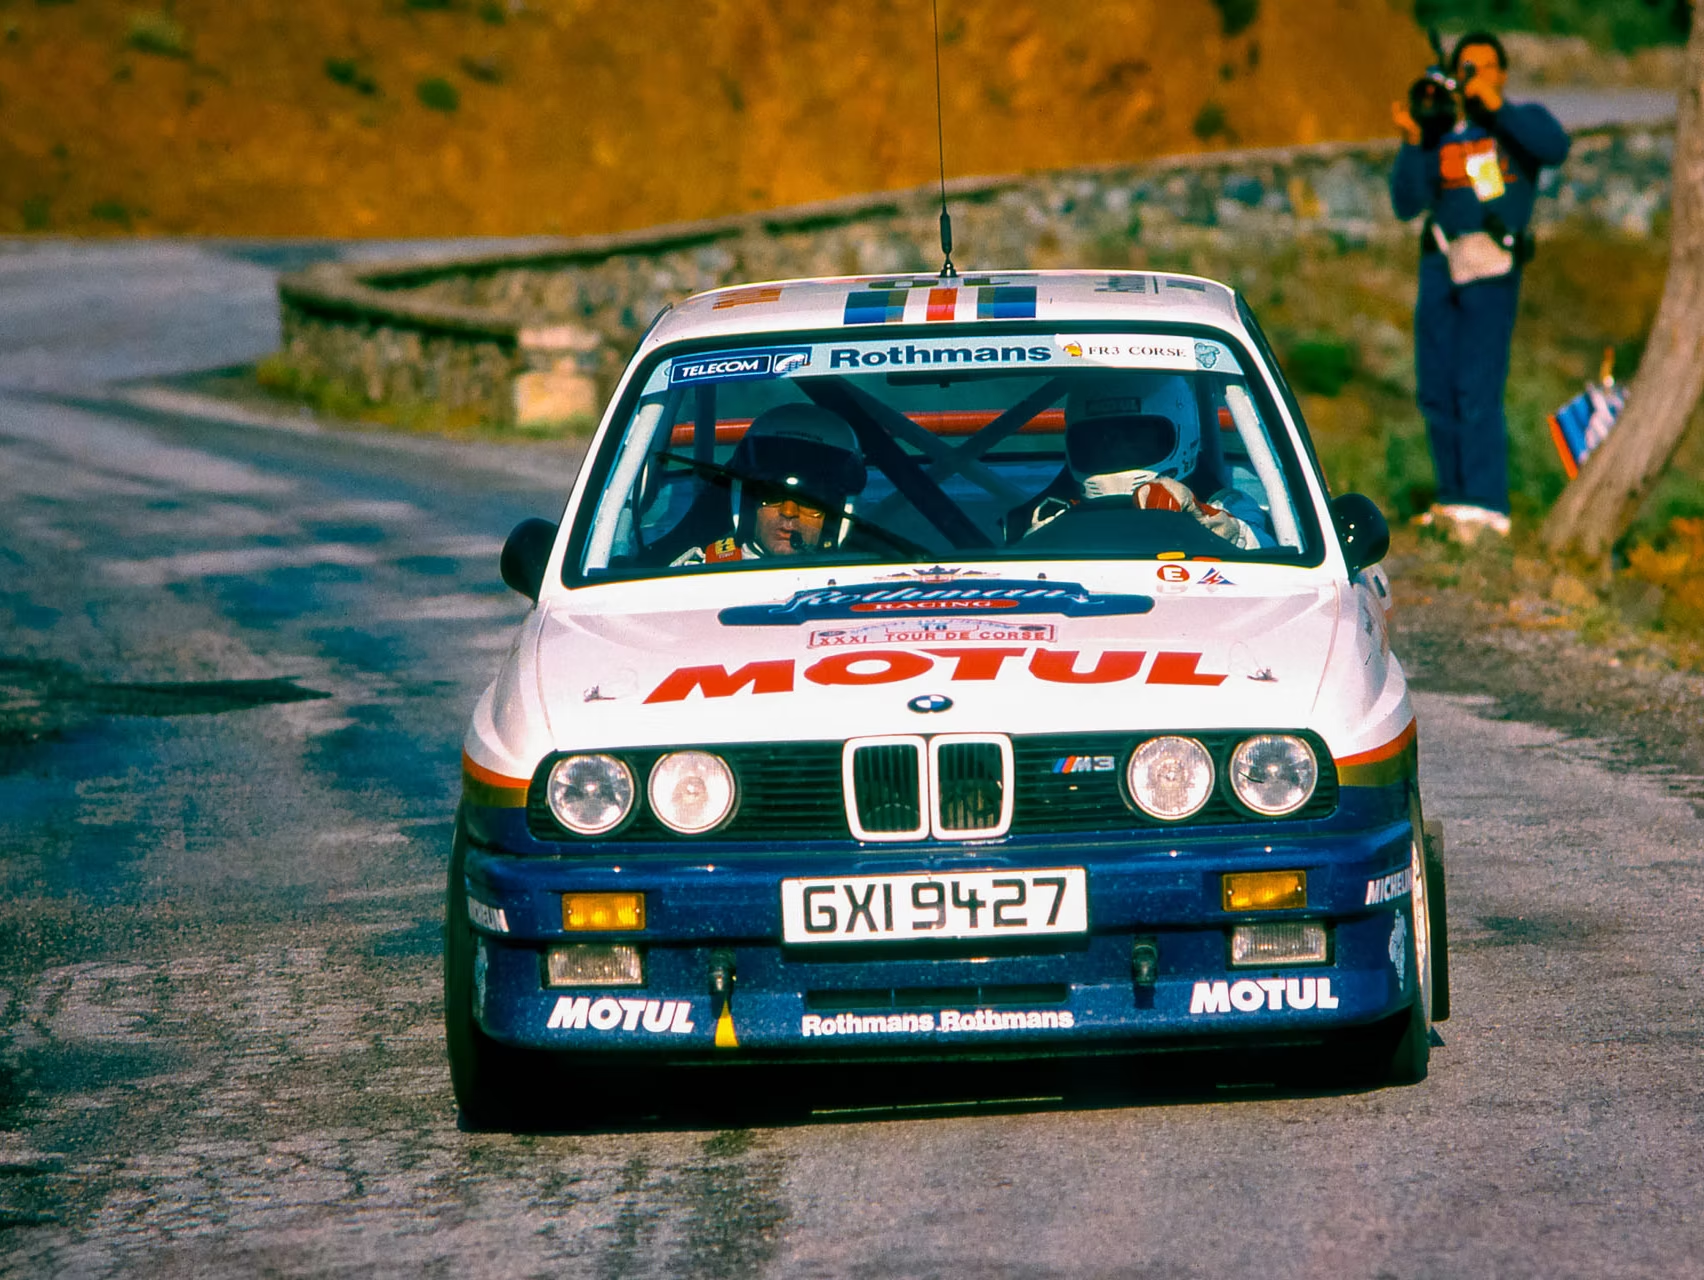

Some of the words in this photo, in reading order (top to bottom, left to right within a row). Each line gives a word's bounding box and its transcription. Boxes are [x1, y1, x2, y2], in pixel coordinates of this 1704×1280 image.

[829, 345, 1052, 369] Rothmans
[1089, 346, 1119, 355] FR3
[1128, 346, 1187, 357] CORSE
[682, 359, 759, 378] TELECOM
[874, 601, 993, 610] RACING
[885, 631, 936, 642] TOUR
[945, 631, 971, 641] DE
[979, 630, 1045, 641] CORSE
[642, 647, 1230, 704] MOTUL
[803, 883, 894, 934] GXI
[911, 876, 1067, 930] 9427
[1189, 977, 1340, 1014] MOTUL
[546, 995, 696, 1033] MOTUL
[802, 1013, 934, 1037] Rothmans
[939, 1009, 1075, 1032] Rothmans
